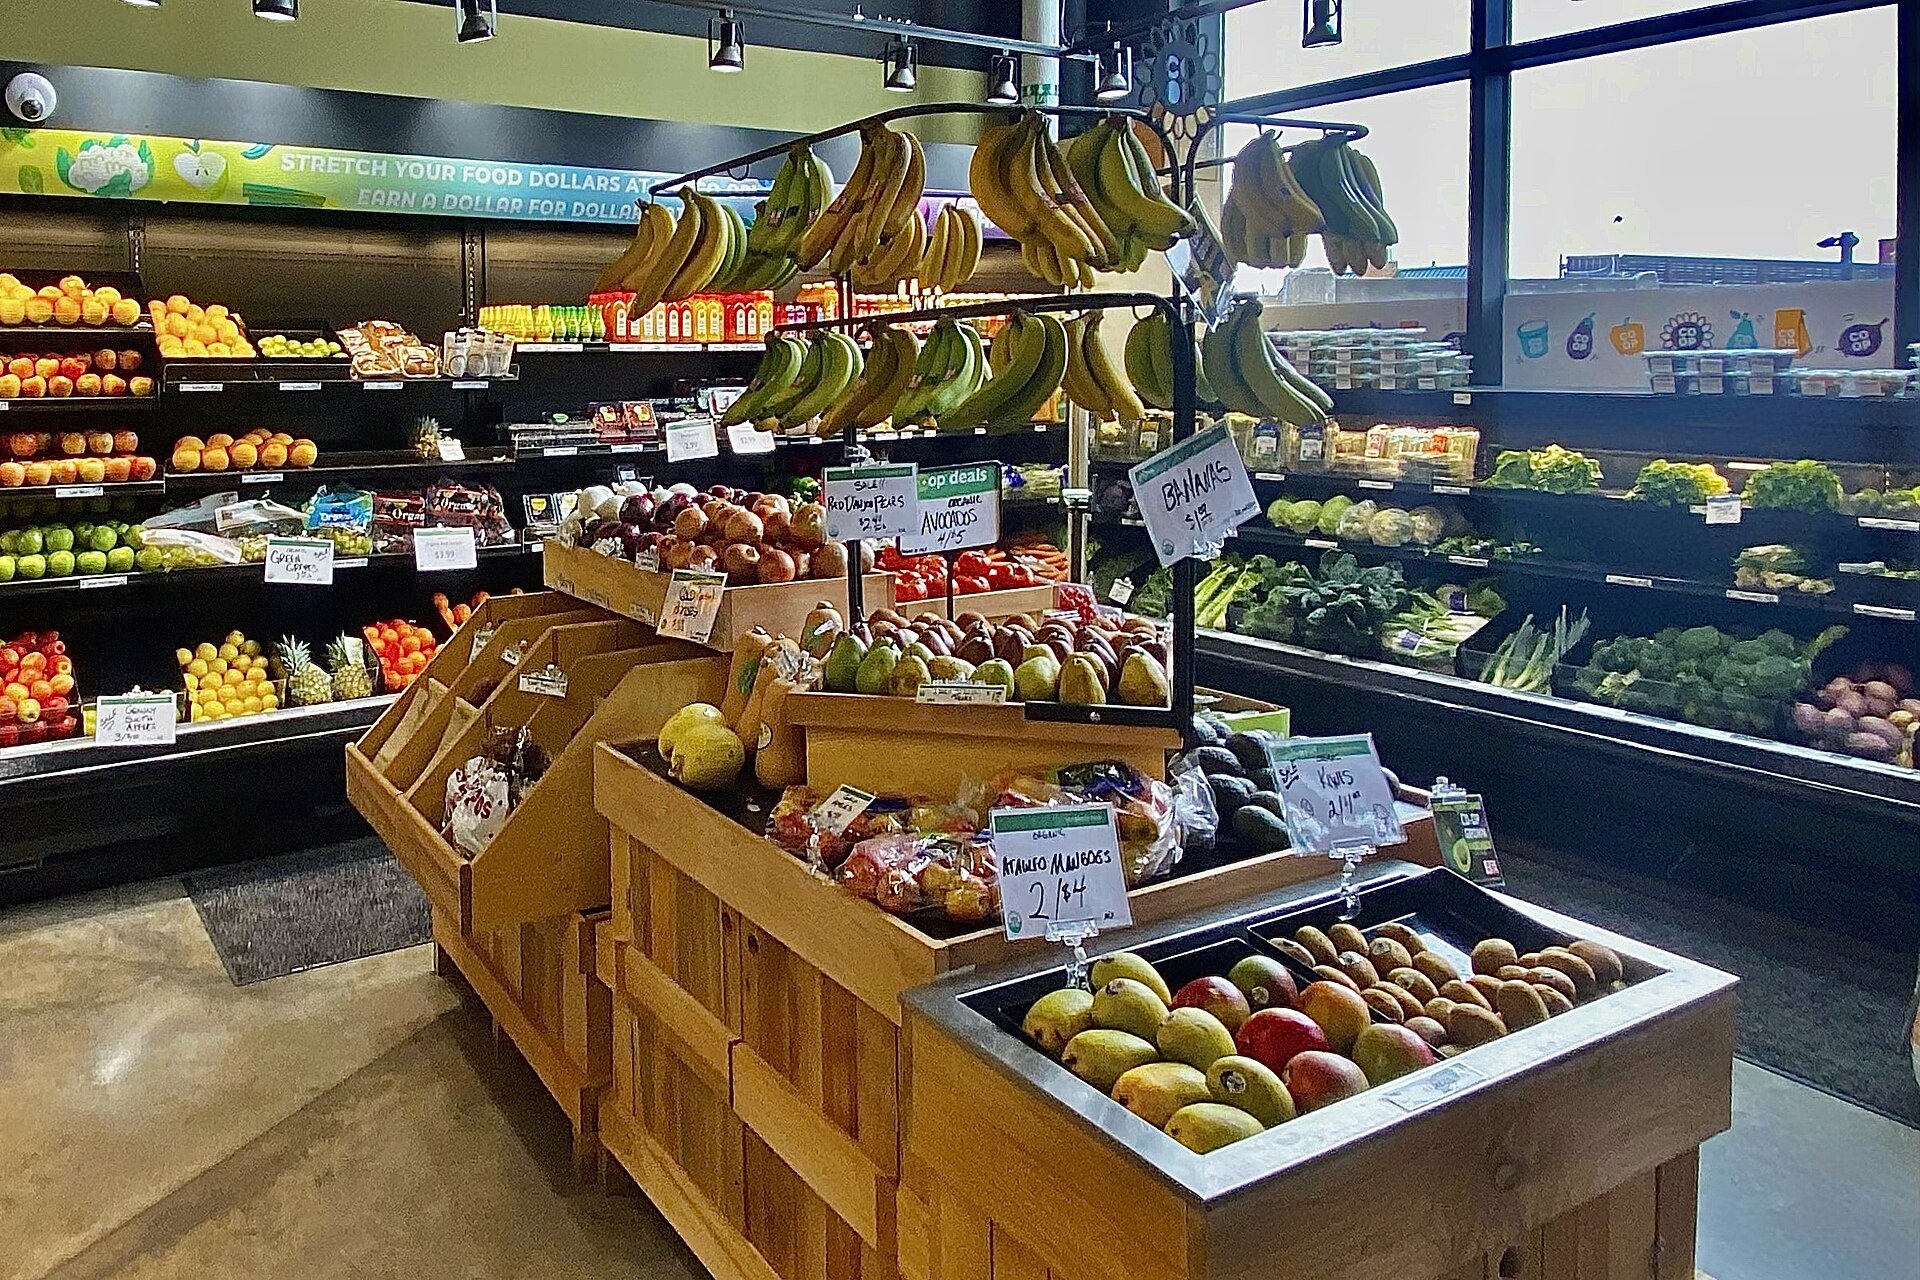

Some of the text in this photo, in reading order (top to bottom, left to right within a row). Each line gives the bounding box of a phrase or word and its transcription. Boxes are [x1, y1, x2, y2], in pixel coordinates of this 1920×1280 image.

[280, 153, 387, 177] STRETCH
[394, 161, 456, 182] YOUR
[462, 166, 523, 186] FOOD
[529, 171, 620, 193] DOLLARS
[625, 178, 649, 194] AT
[358, 188, 415, 208] EARN
[421, 193, 437, 209] A
[442, 194, 522, 214] DOLLAR
[527, 199, 566, 217] FOR
[1678, 327, 1697, 337] CO
[1849, 330, 1869, 342] CO
[1851, 340, 1871, 352] OP
[950, 467, 988, 484] deals
[1161, 460, 1232, 512] BANANAS
[921, 507, 978, 535] AVOCADOS
